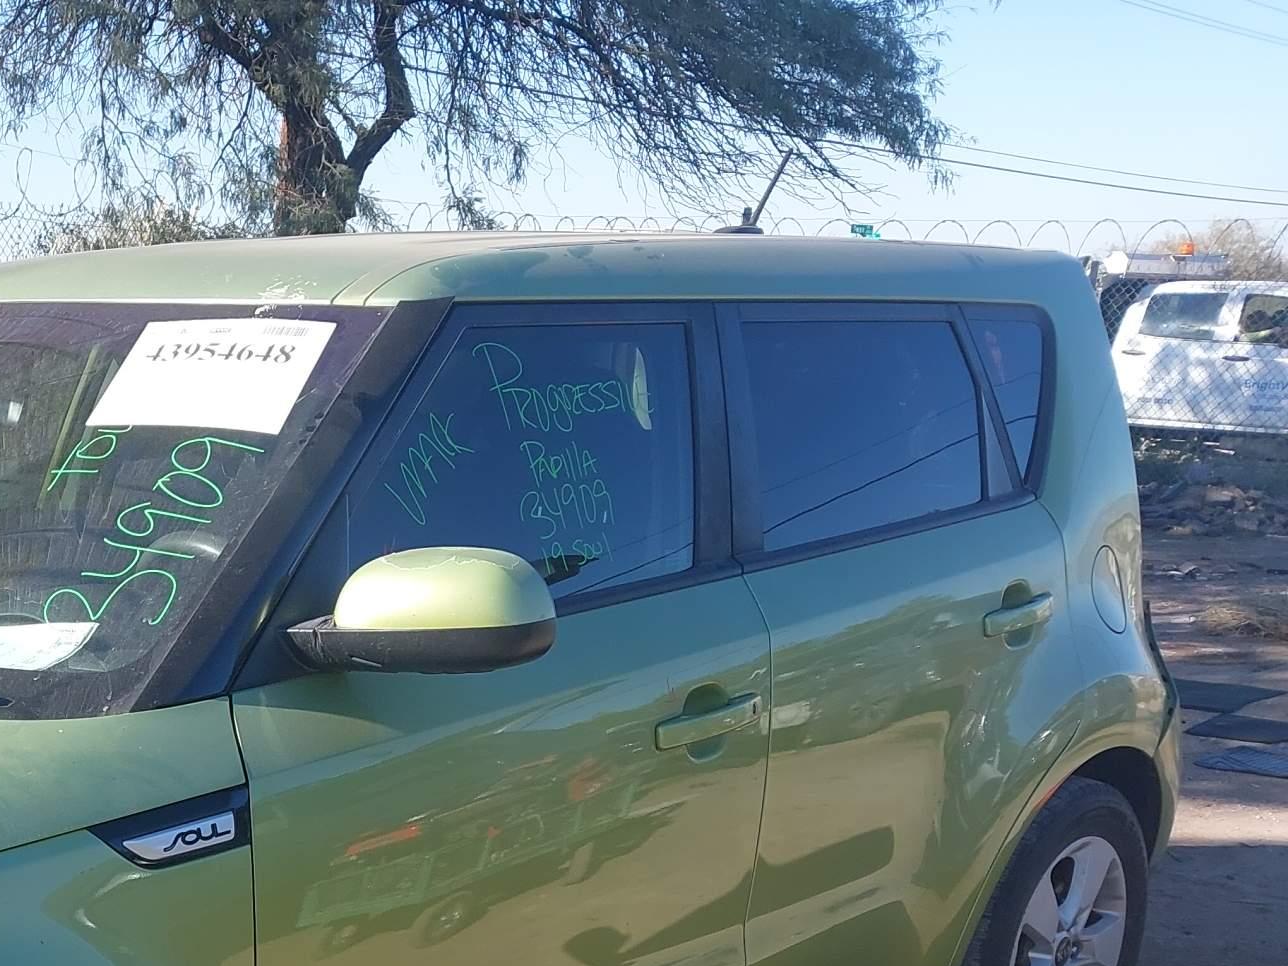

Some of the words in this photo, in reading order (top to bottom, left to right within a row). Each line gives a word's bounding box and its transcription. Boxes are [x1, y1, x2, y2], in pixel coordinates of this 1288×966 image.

[146, 342, 297, 364] 43954648
[44, 436, 266, 626] 34909
[162, 822, 232, 853] SOUL
